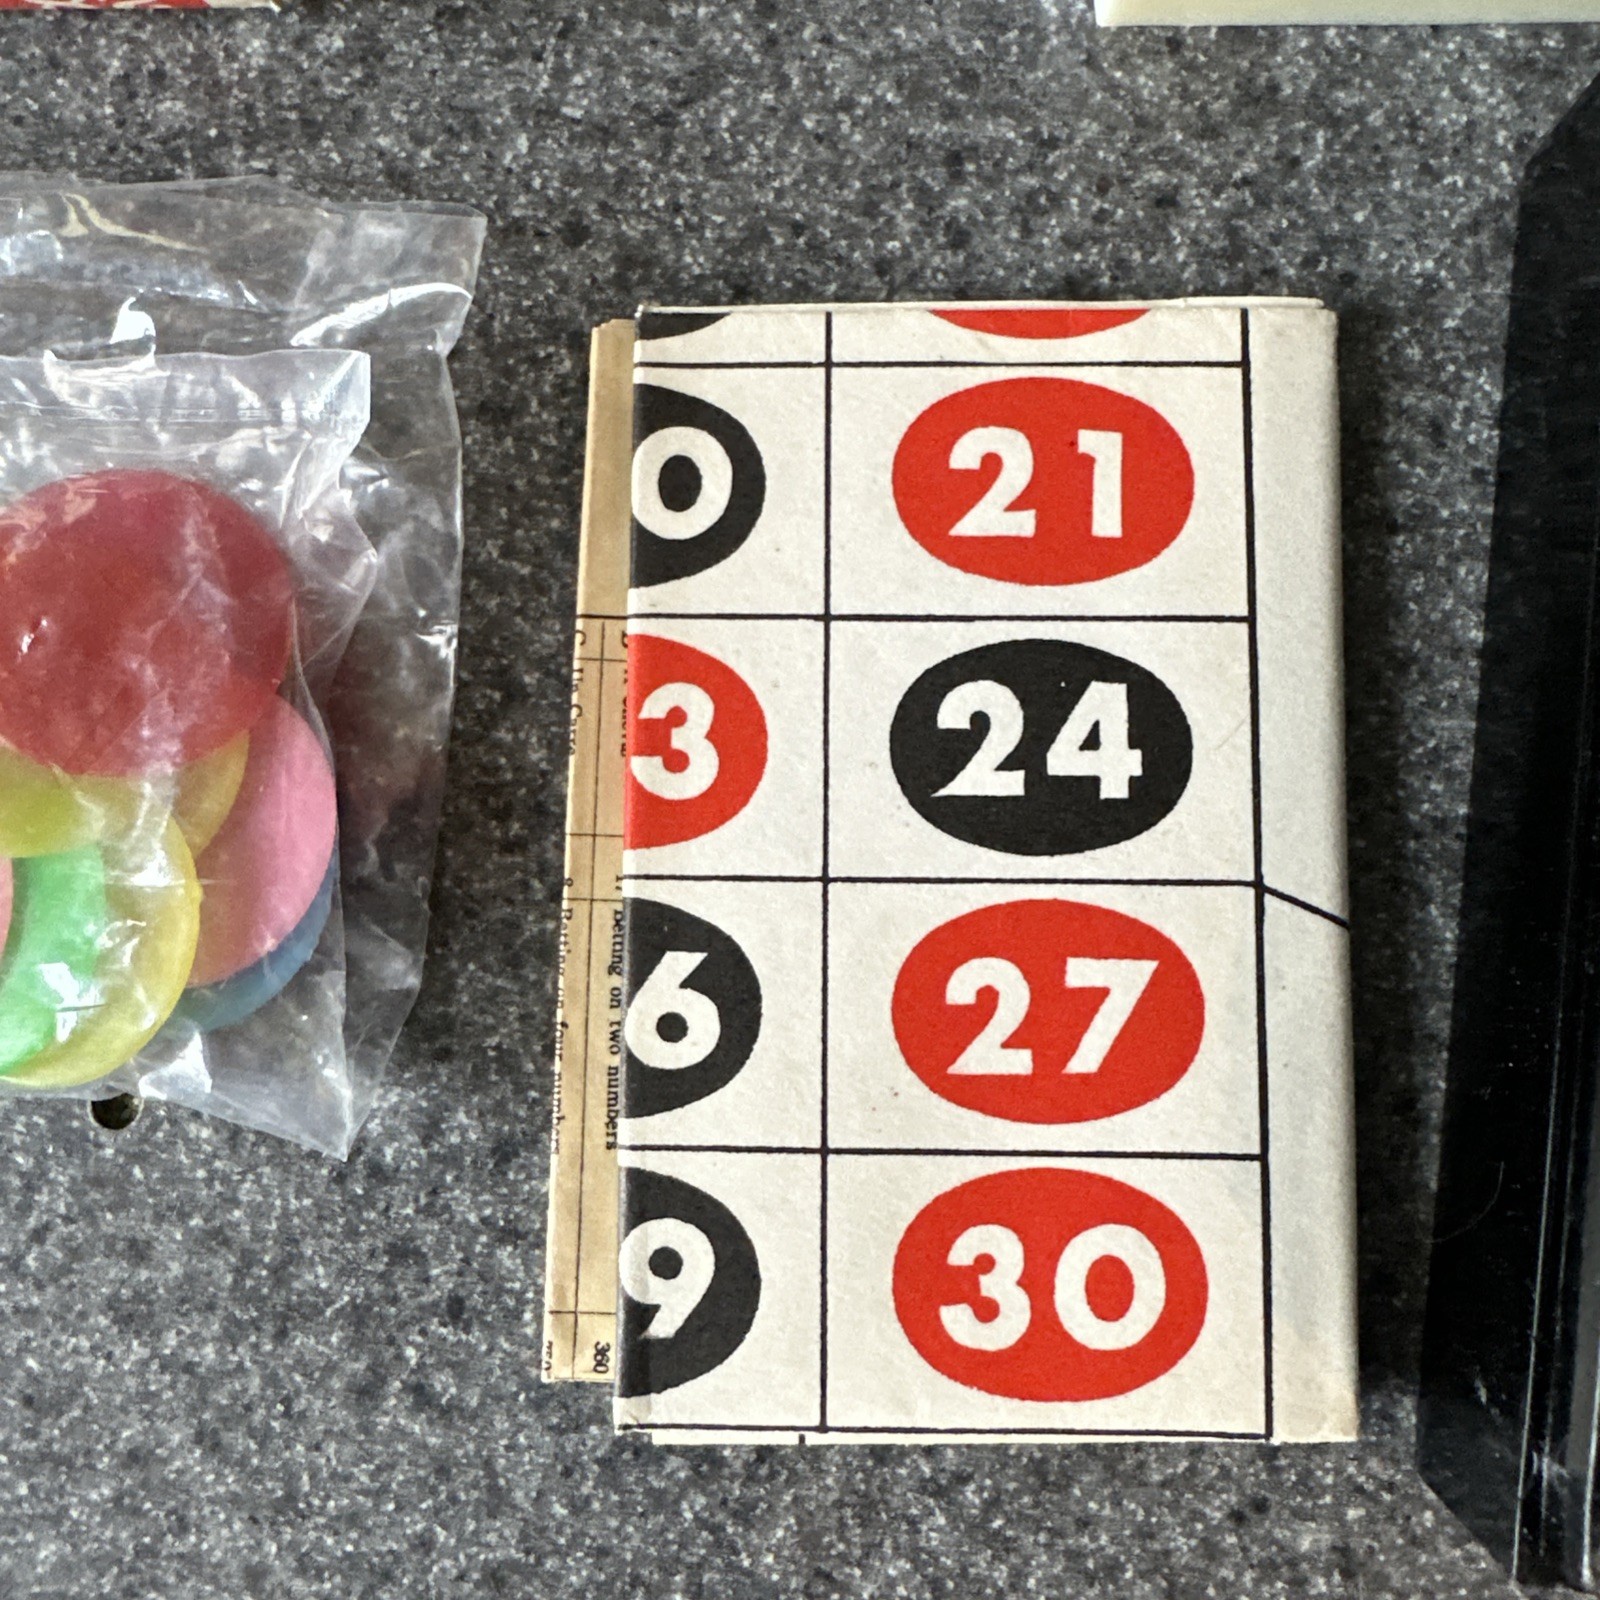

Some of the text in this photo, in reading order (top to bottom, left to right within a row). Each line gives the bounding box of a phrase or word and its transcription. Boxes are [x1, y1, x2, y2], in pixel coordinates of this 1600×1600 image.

[949, 426, 1123, 538] 21
[932, 680, 1143, 800] 24
[609, 987, 621, 1009] on
[609, 1021, 621, 1055] two
[946, 957, 1159, 1075] 27
[605, 1066, 619, 1150] numbers
[940, 1224, 1167, 1352] 30
[593, 1341, 611, 1374] 360
